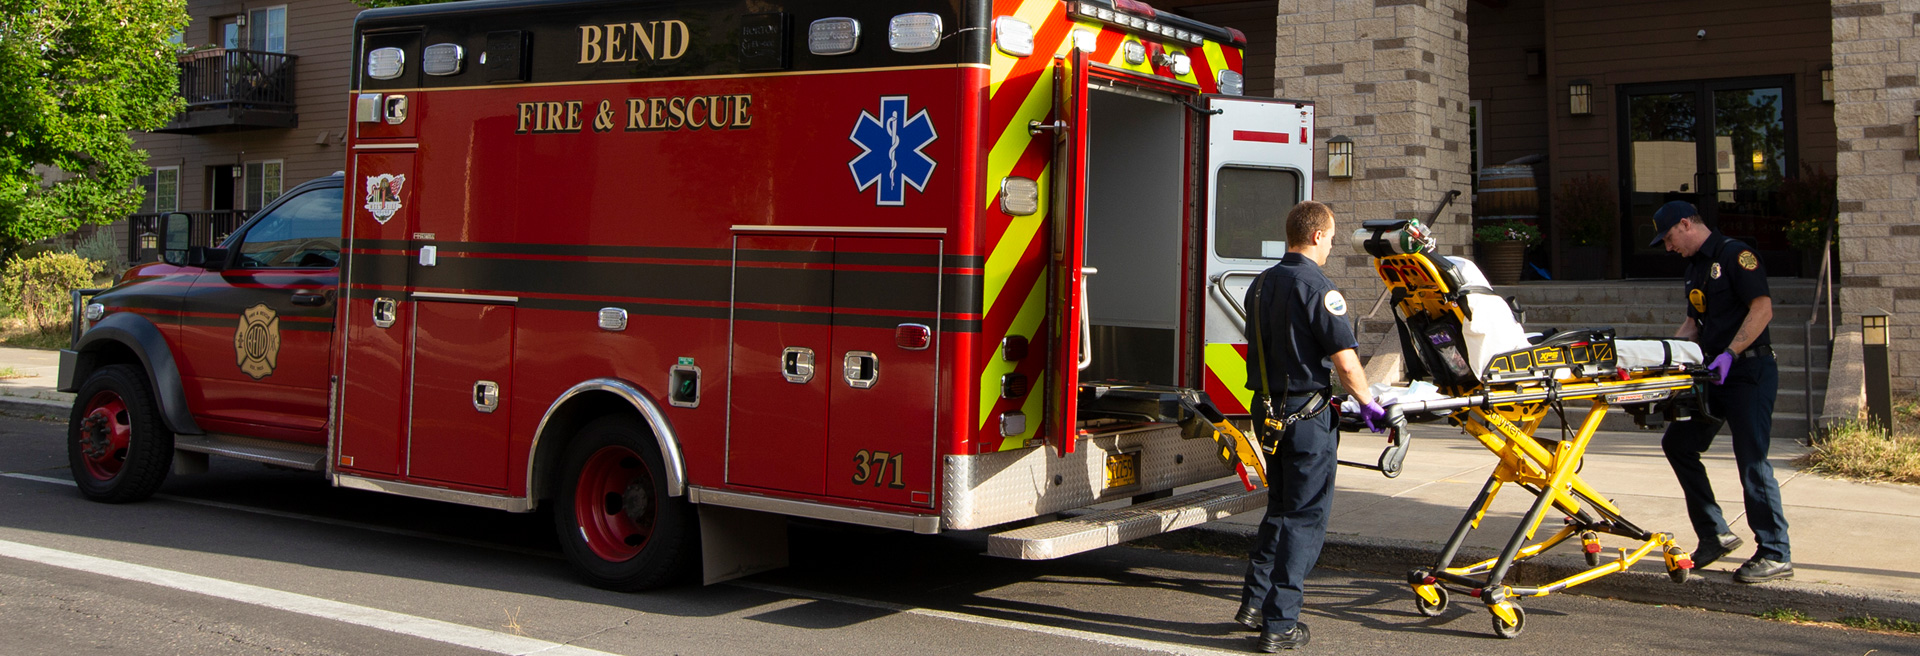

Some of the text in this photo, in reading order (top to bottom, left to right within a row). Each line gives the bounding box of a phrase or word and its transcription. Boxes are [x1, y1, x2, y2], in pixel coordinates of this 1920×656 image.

[577, 19, 690, 64] BEND
[516, 94, 753, 133] FIRE & RESCUE
[247, 326, 267, 357] BEND
[852, 449, 905, 489] 371
